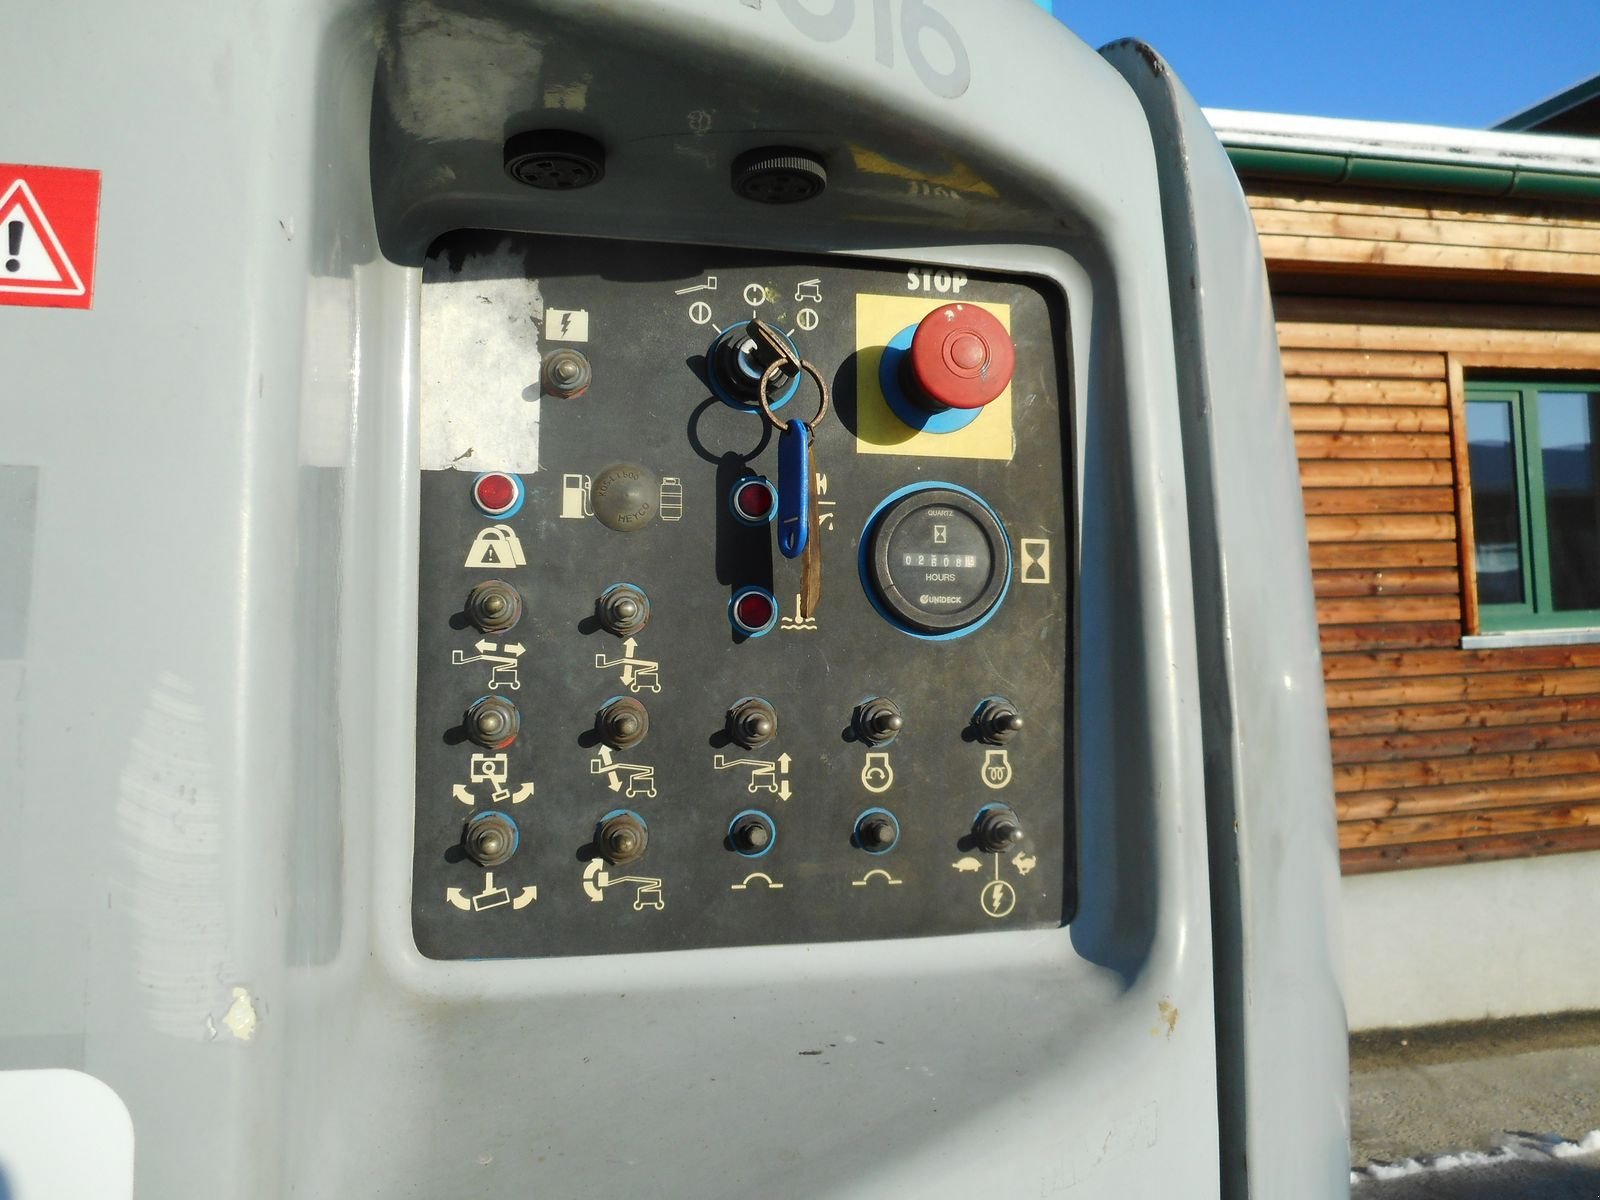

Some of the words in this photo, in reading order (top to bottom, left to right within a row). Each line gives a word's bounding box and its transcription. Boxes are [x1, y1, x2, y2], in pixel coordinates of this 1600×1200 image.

[907, 267, 968, 294] STOP
[617, 502, 650, 523] HEYCO
[927, 509, 954, 517] QUARTZ
[925, 573, 956, 582] HOURS
